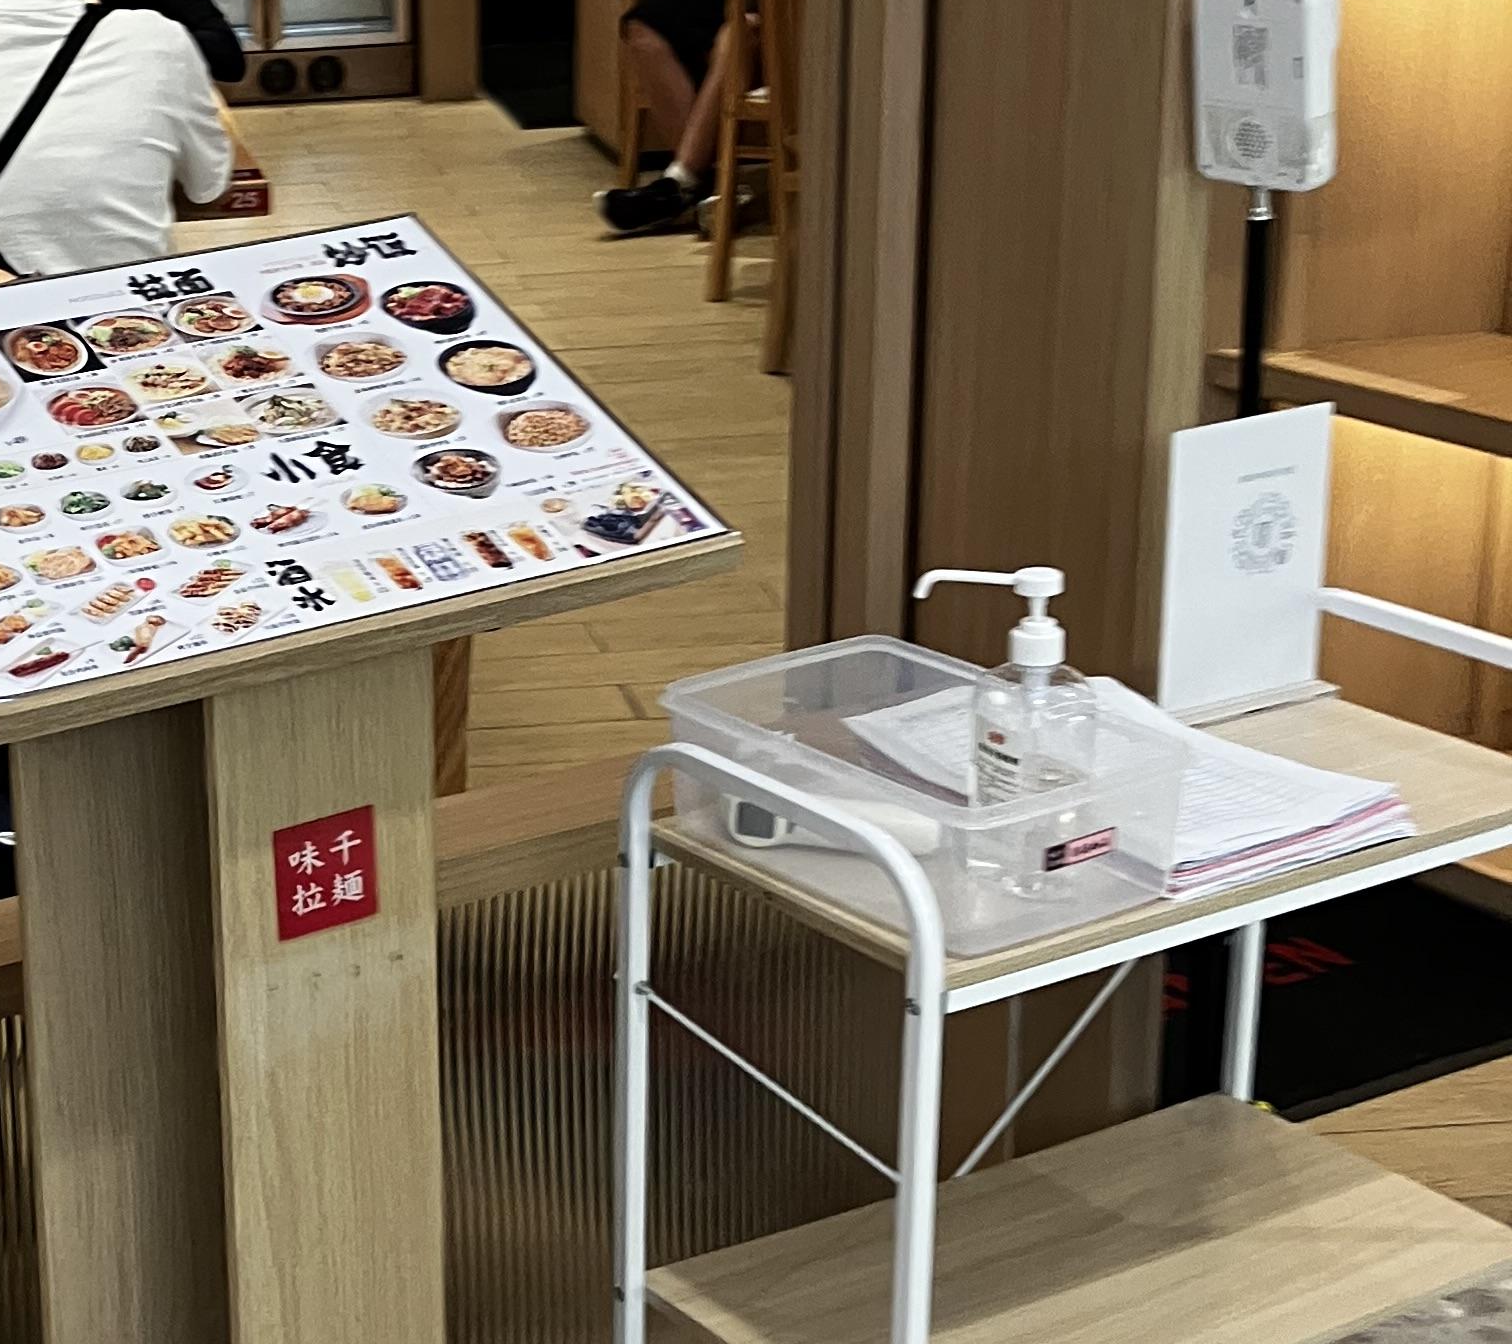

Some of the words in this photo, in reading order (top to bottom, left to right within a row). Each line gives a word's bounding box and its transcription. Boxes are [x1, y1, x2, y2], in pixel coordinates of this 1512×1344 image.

[232, 193, 260, 208] 25
[261, 440, 366, 483] 小食
[288, 830, 362, 875] 味千
